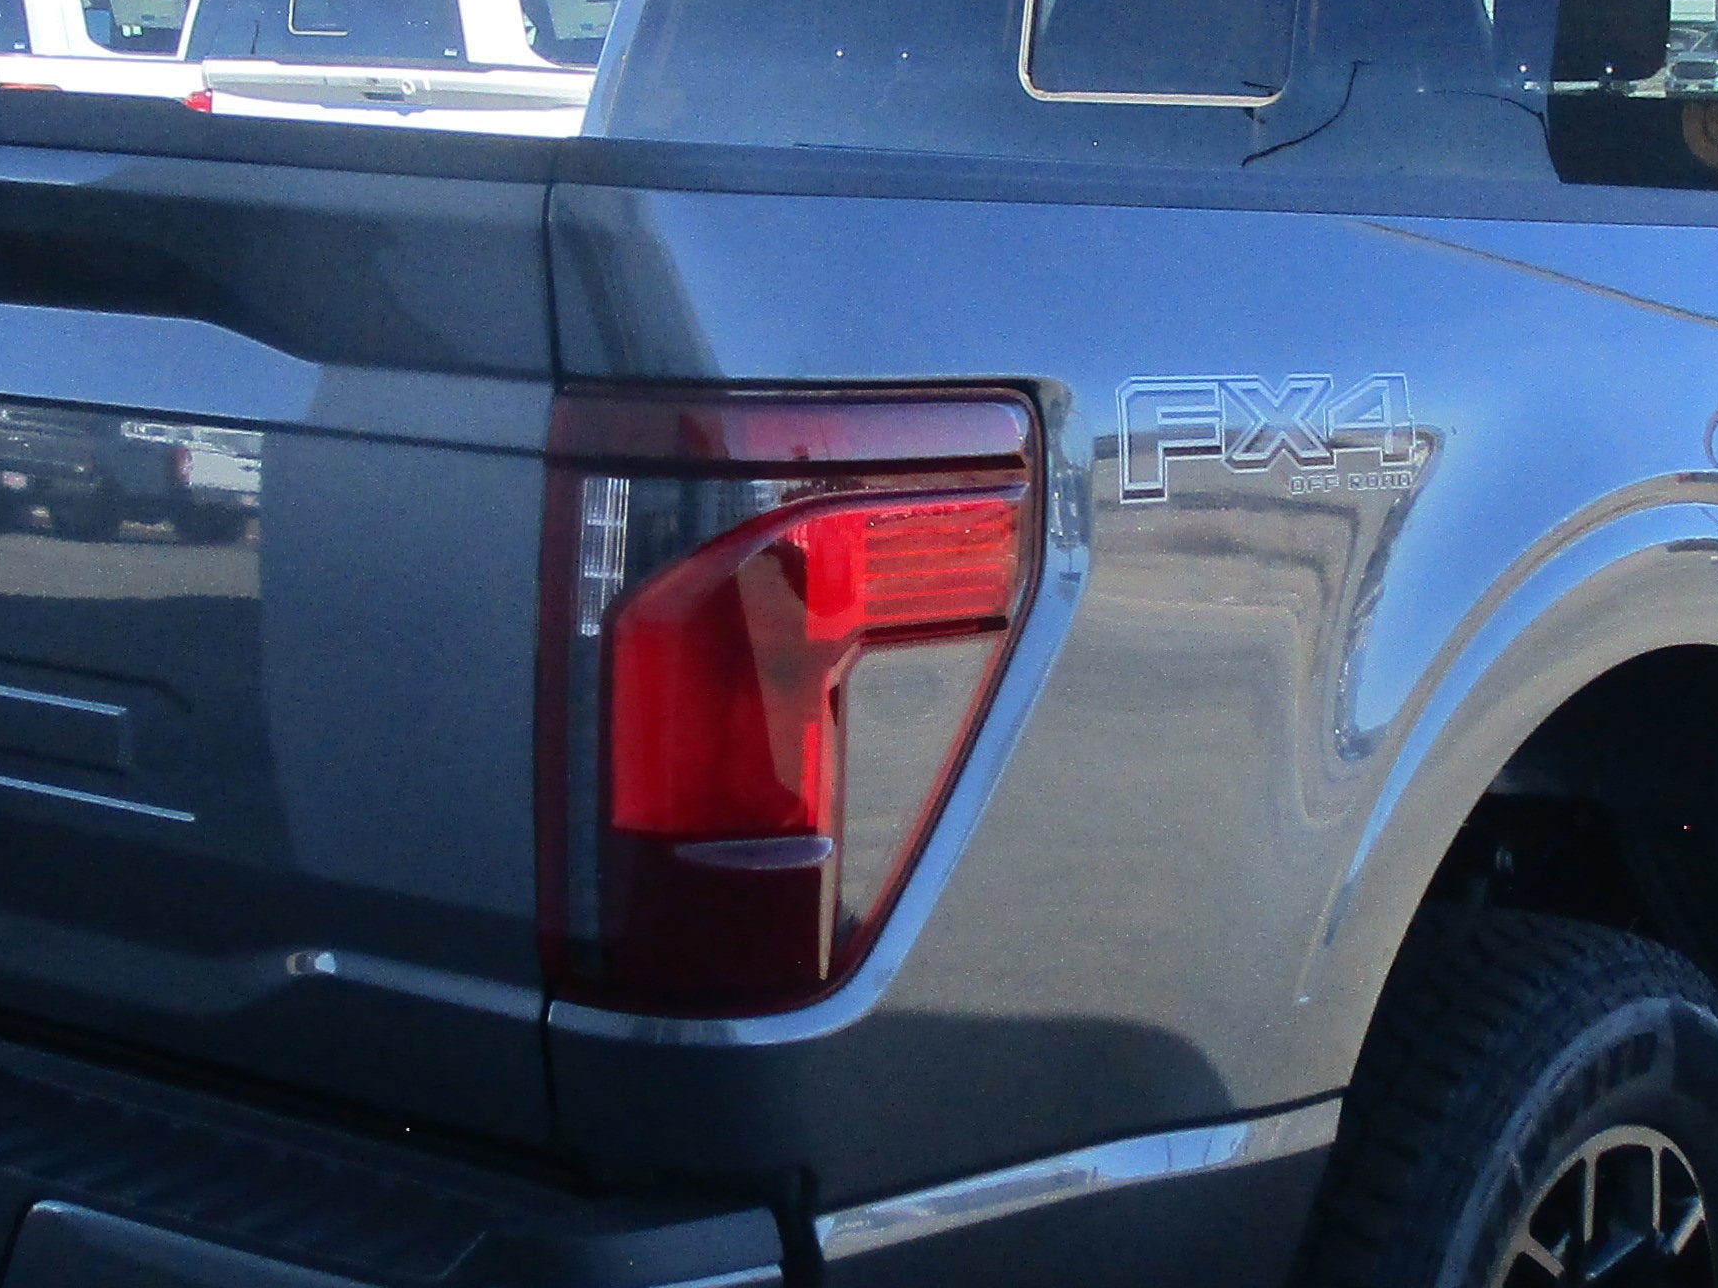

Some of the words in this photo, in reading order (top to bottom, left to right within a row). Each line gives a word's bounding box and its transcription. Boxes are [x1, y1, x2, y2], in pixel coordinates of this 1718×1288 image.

[1115, 373, 1416, 505] FX4
[1290, 474, 1340, 495] OFF
[1347, 471, 1414, 491] ROAD
